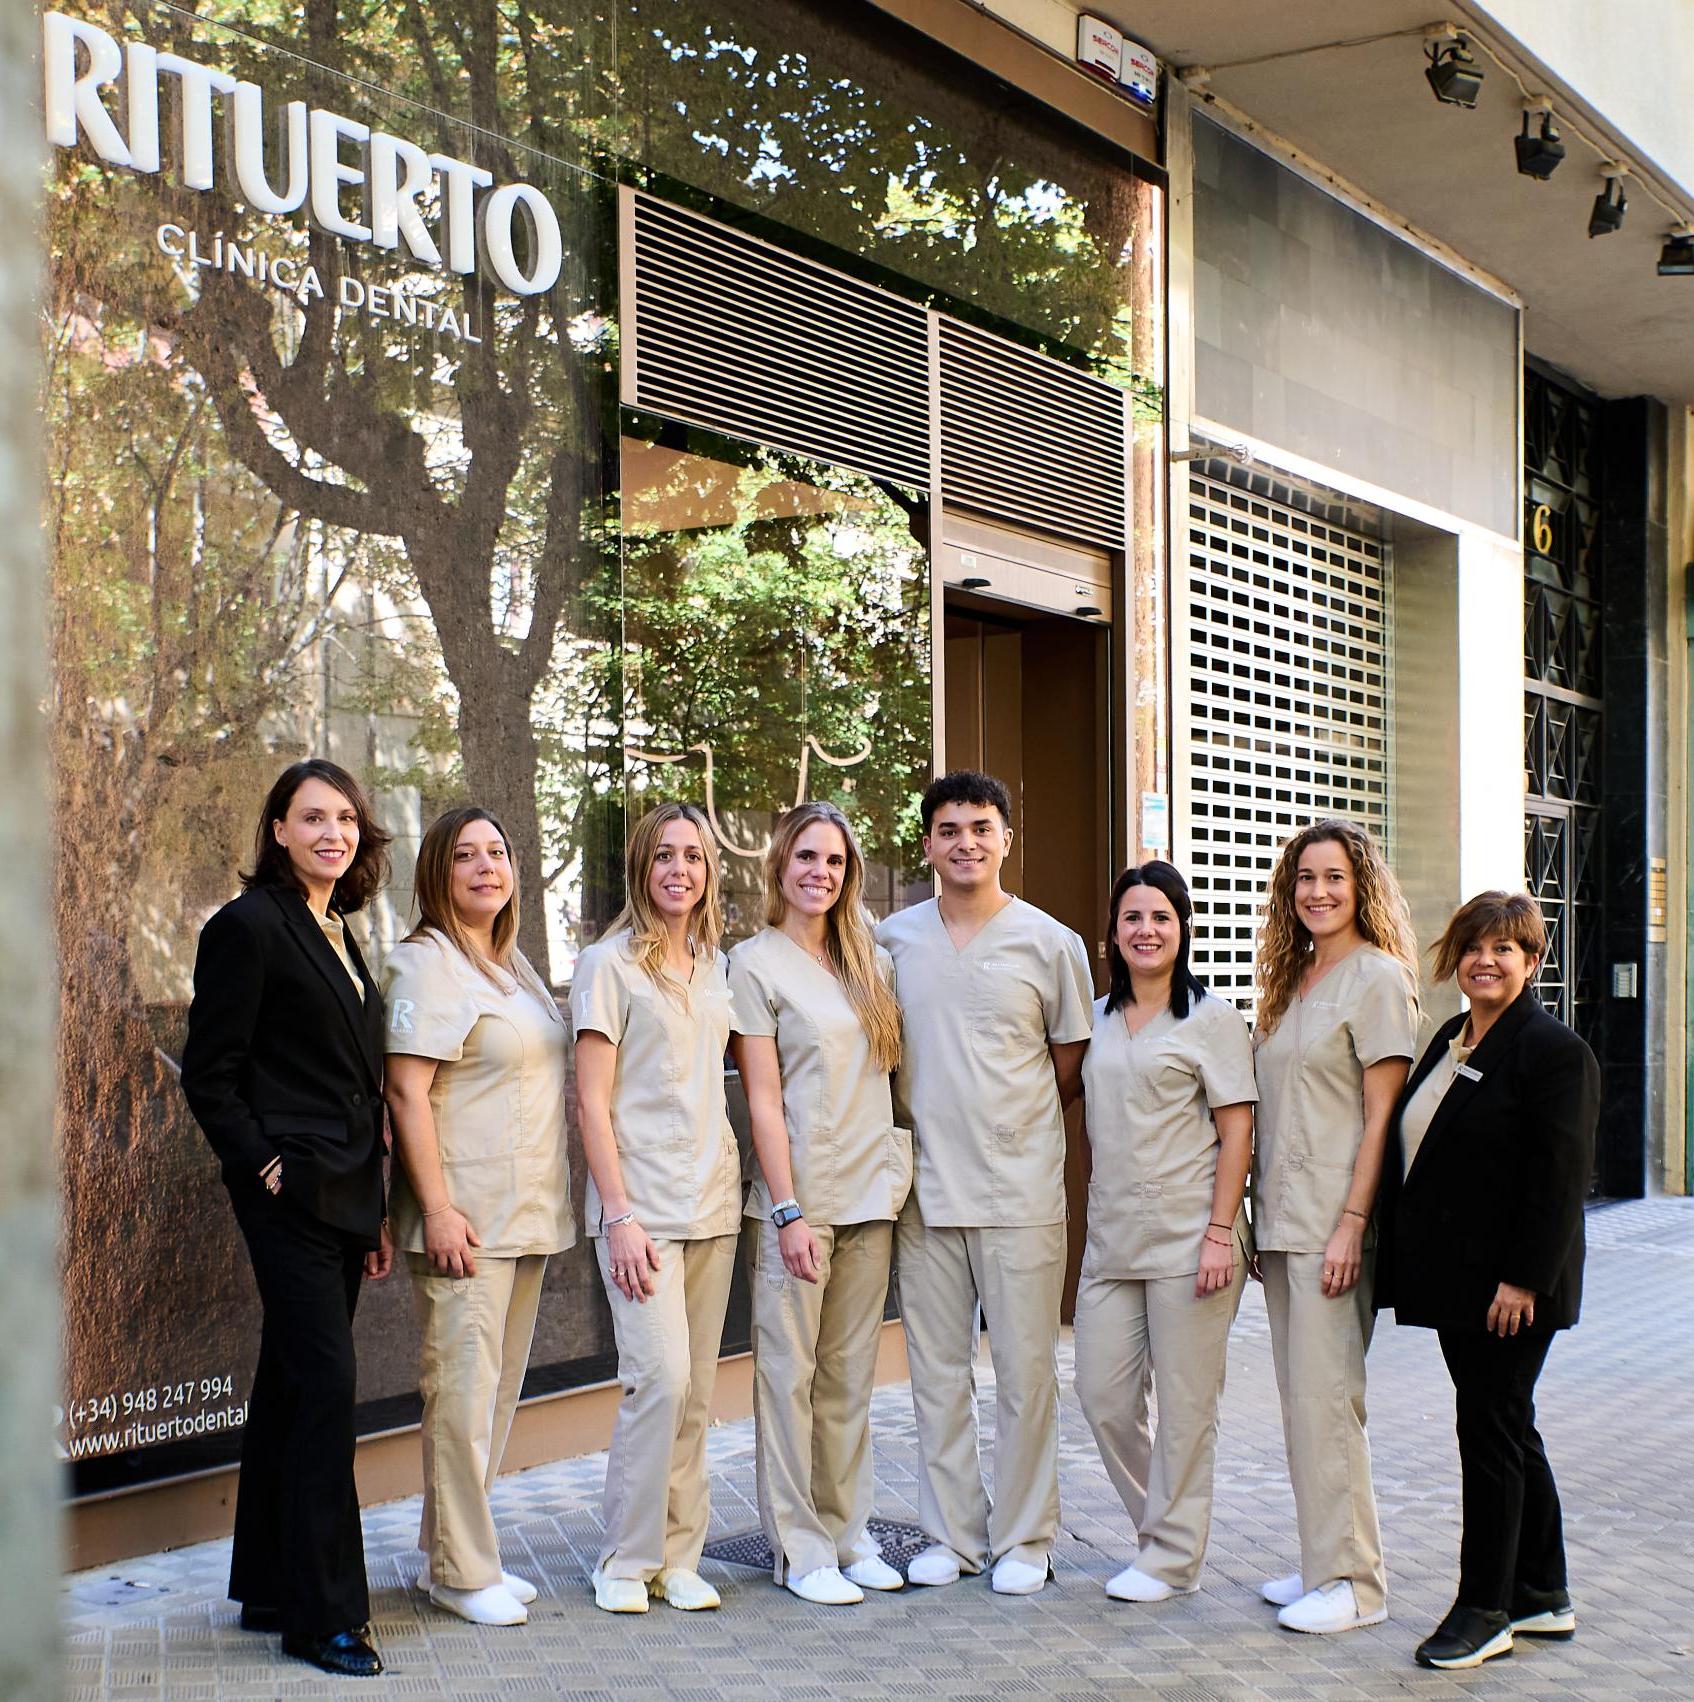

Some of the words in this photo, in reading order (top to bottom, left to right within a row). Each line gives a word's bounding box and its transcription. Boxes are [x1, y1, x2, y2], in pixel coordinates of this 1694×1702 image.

[44, 12, 562, 295] RITUERTO
[157, 224, 324, 298] CLÍNICA
[340, 276, 482, 343] DENTAL
[1533, 505, 1552, 554] 6
[392, 998, 415, 1030] R
[69, 1394, 117, 1430] (+34)
[123, 1388, 157, 1415] 948
[162, 1381, 195, 1408] 247
[200, 1376, 233, 1401] 994
[69, 1401, 249, 1457] www.rituertodental
